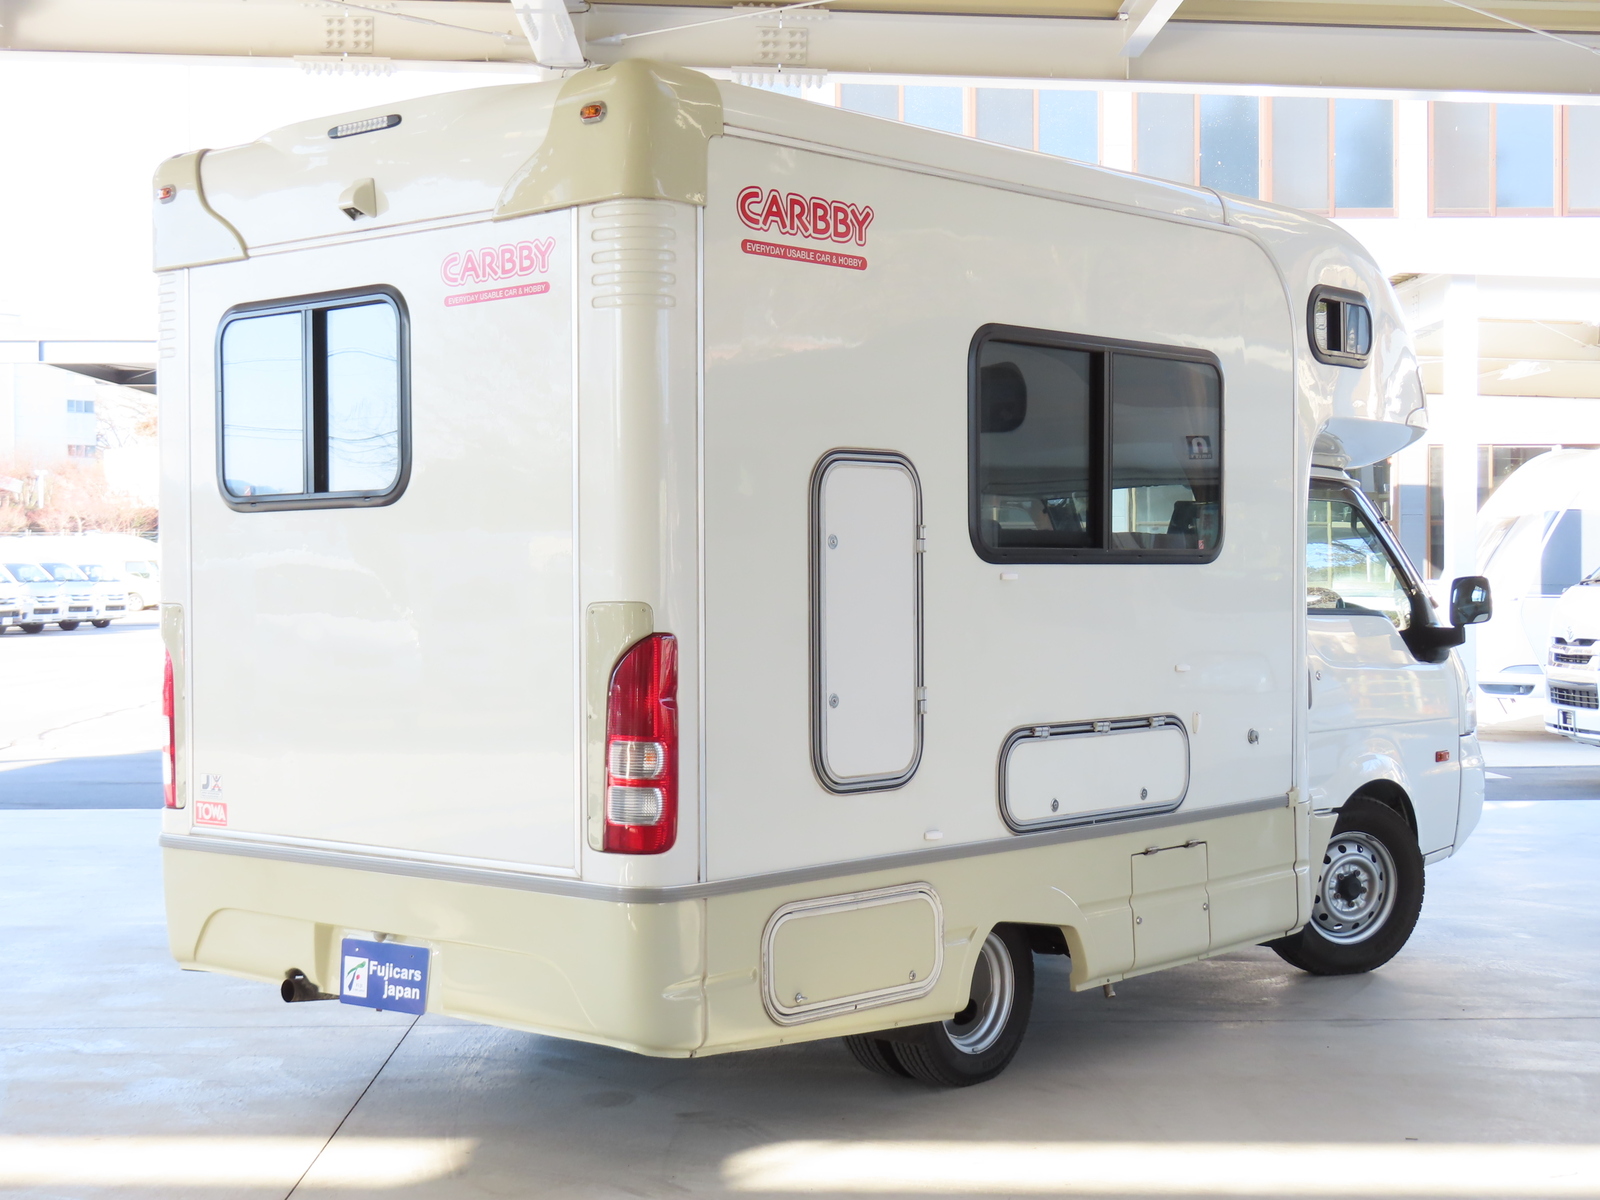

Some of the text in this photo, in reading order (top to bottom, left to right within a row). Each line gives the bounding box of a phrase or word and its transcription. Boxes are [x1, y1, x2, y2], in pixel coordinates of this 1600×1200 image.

[737, 185, 874, 247] CARBBY
[441, 236, 556, 288] CARBBY
[746, 242, 863, 267] EVERYDAY USABLE CAR & HOBBY
[448, 284, 546, 305] EVERYDAY USABLE CAR & HOBBY
[196, 802, 227, 821] TOWA
[369, 960, 422, 981] Fujicars
[382, 980, 420, 1000] japan
